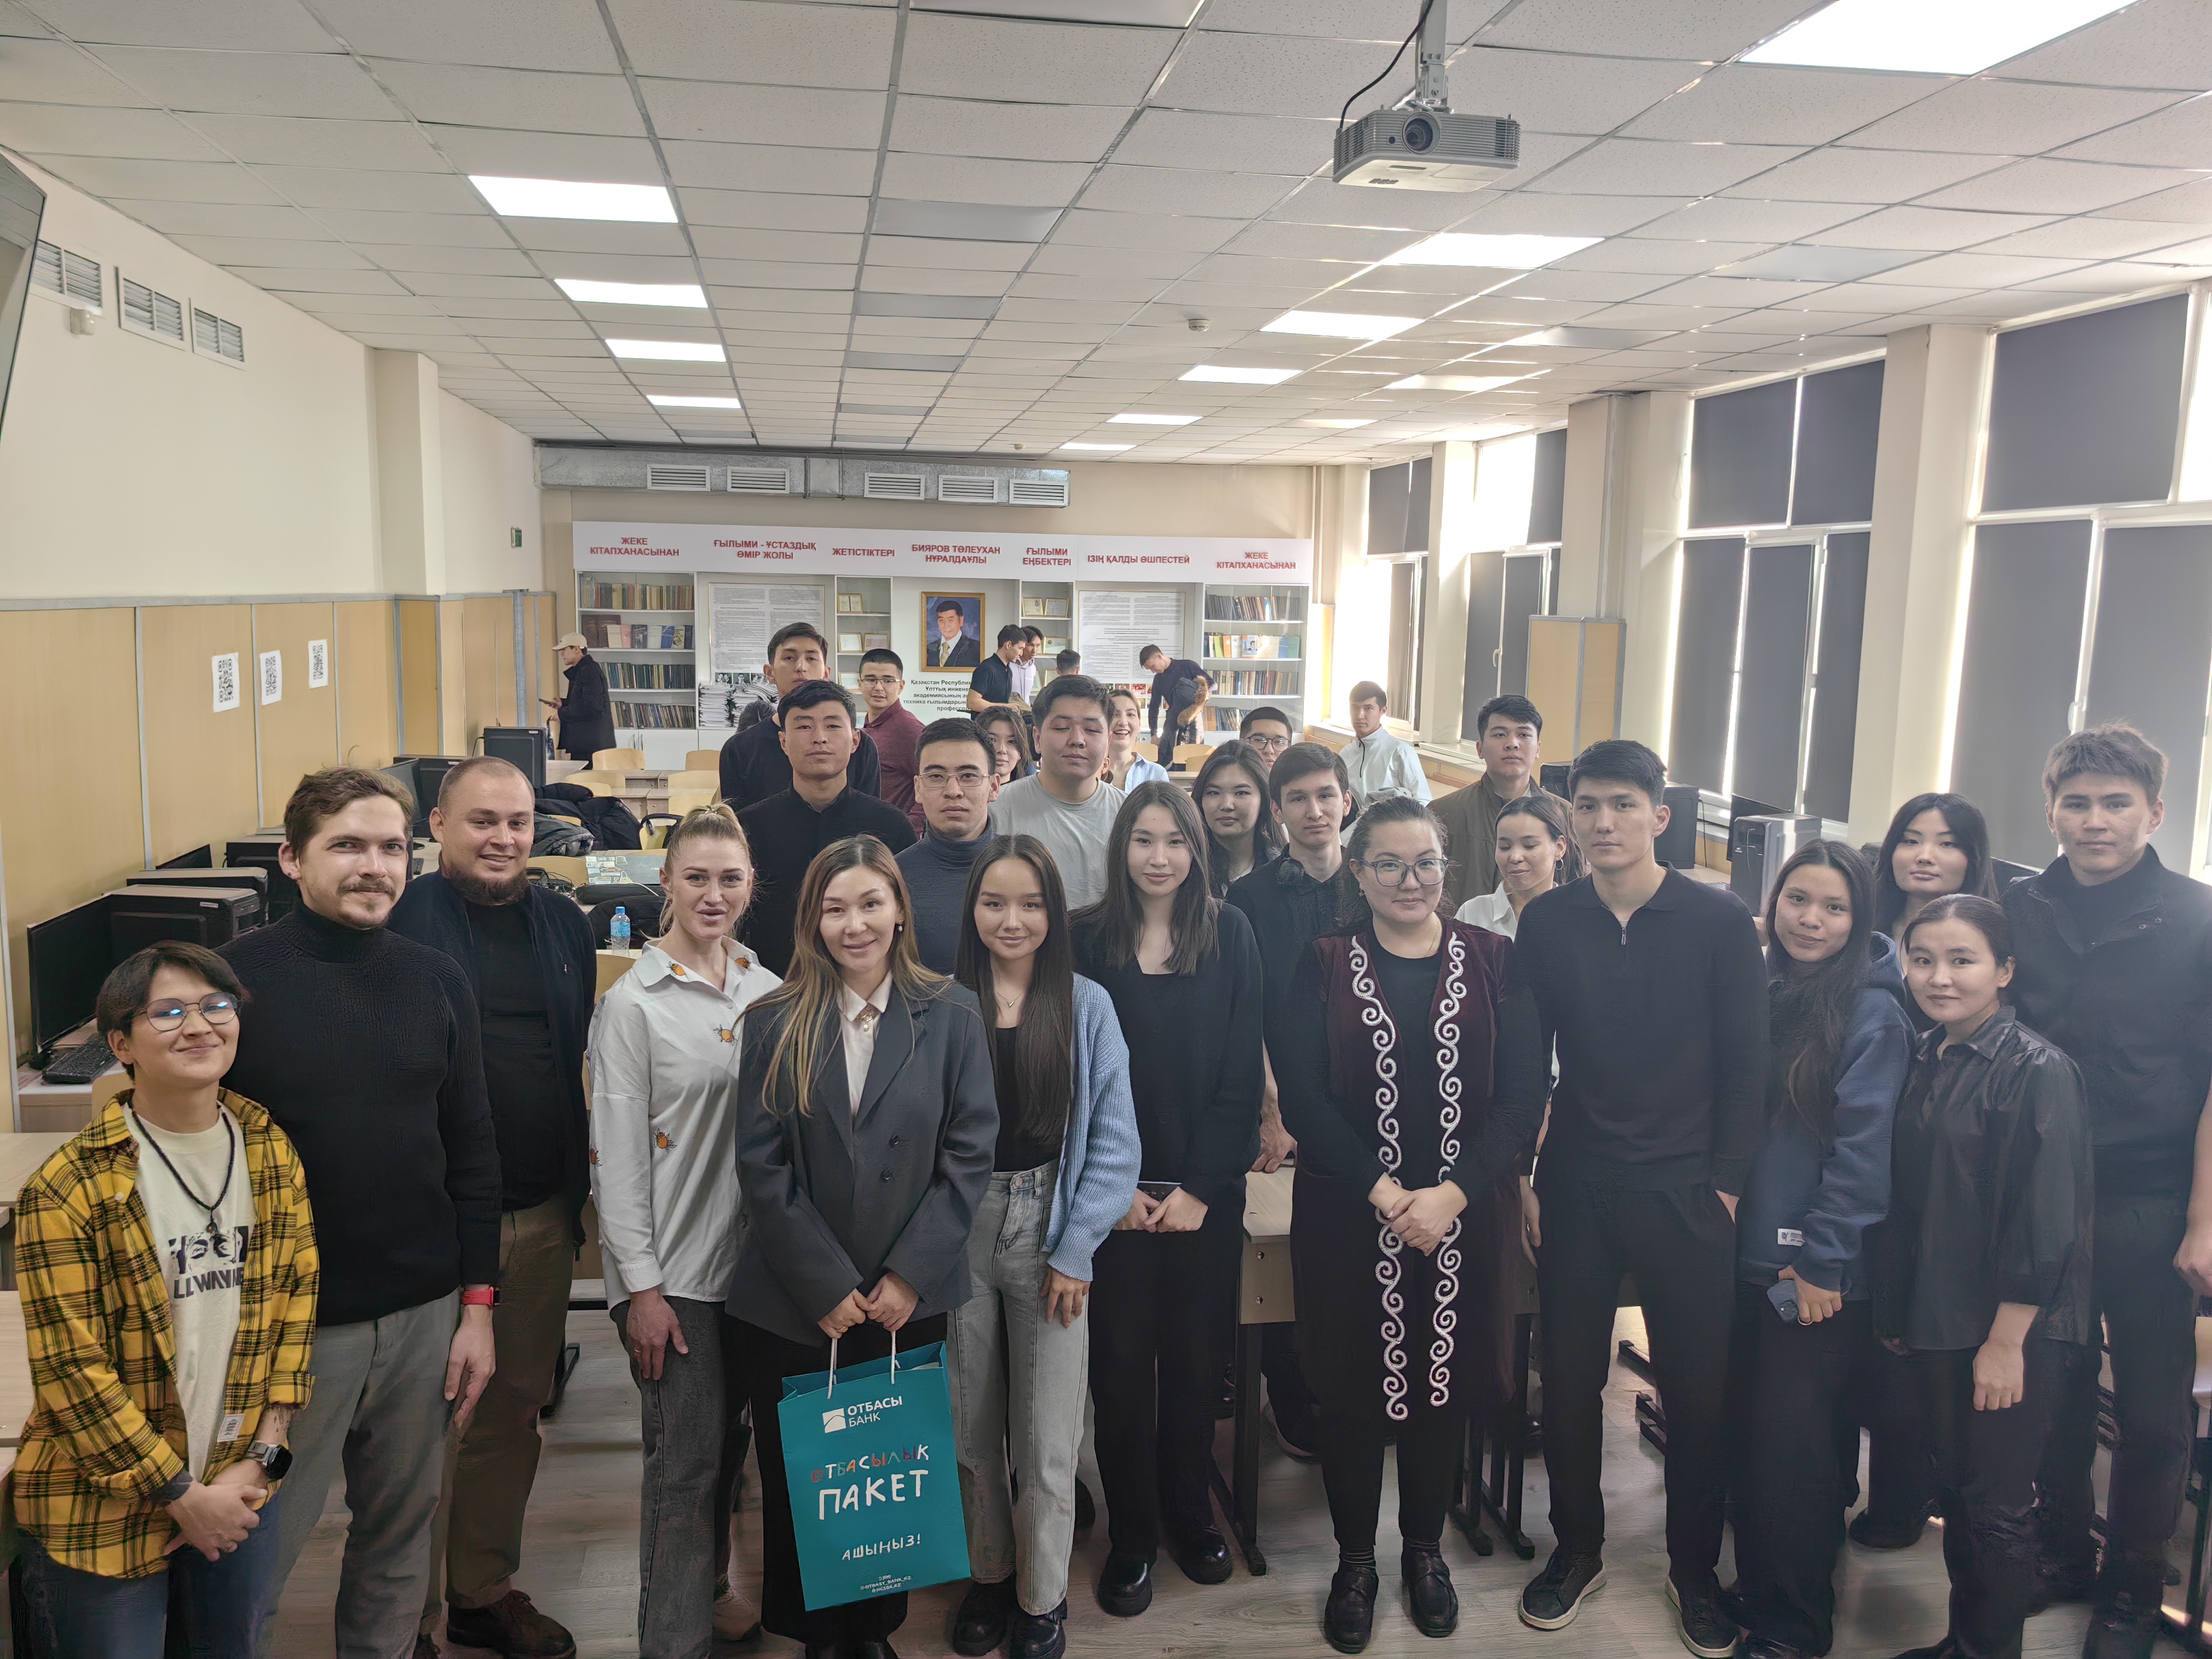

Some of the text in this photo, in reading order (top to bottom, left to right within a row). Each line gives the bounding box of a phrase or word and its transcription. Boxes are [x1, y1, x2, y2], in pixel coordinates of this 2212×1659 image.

[621, 537, 648, 545] ЖЕКЕ
[713, 539, 758, 548] ҒЫЛЫМИ
[766, 541, 817, 551] ҰСТАЗДЫҚ
[590, 547, 679, 556] КІТАПХАНАСЫНАН
[832, 548, 895, 557] ЖЕТІСТІКТЕРІ
[912, 544, 1001, 554] БИЯРОВ ТӨЛЕУХАН
[1026, 547, 1068, 556] ҒЫЛЫМИ
[737, 550, 794, 559] ӨМІР ЖОЛЫ
[926, 555, 987, 564] НҰРАЛДАҰЛЫ
[1022, 557, 1071, 566] ЕҢБЕКТЕРІ
[1087, 555, 1190, 564] ІЗІҢ ҚАЛДЫ ӨШПЕСТЕЙ
[1217, 561, 1296, 569] КІТАПХАНАСЫНАН
[847, 1395, 903, 1416] ОТБАСЫ
[848, 1411, 881, 1427] БАНК
[811, 1444, 929, 1483] ОТБАСЫЛЫҚ
[819, 1469, 929, 1520] ПАКЕТ
